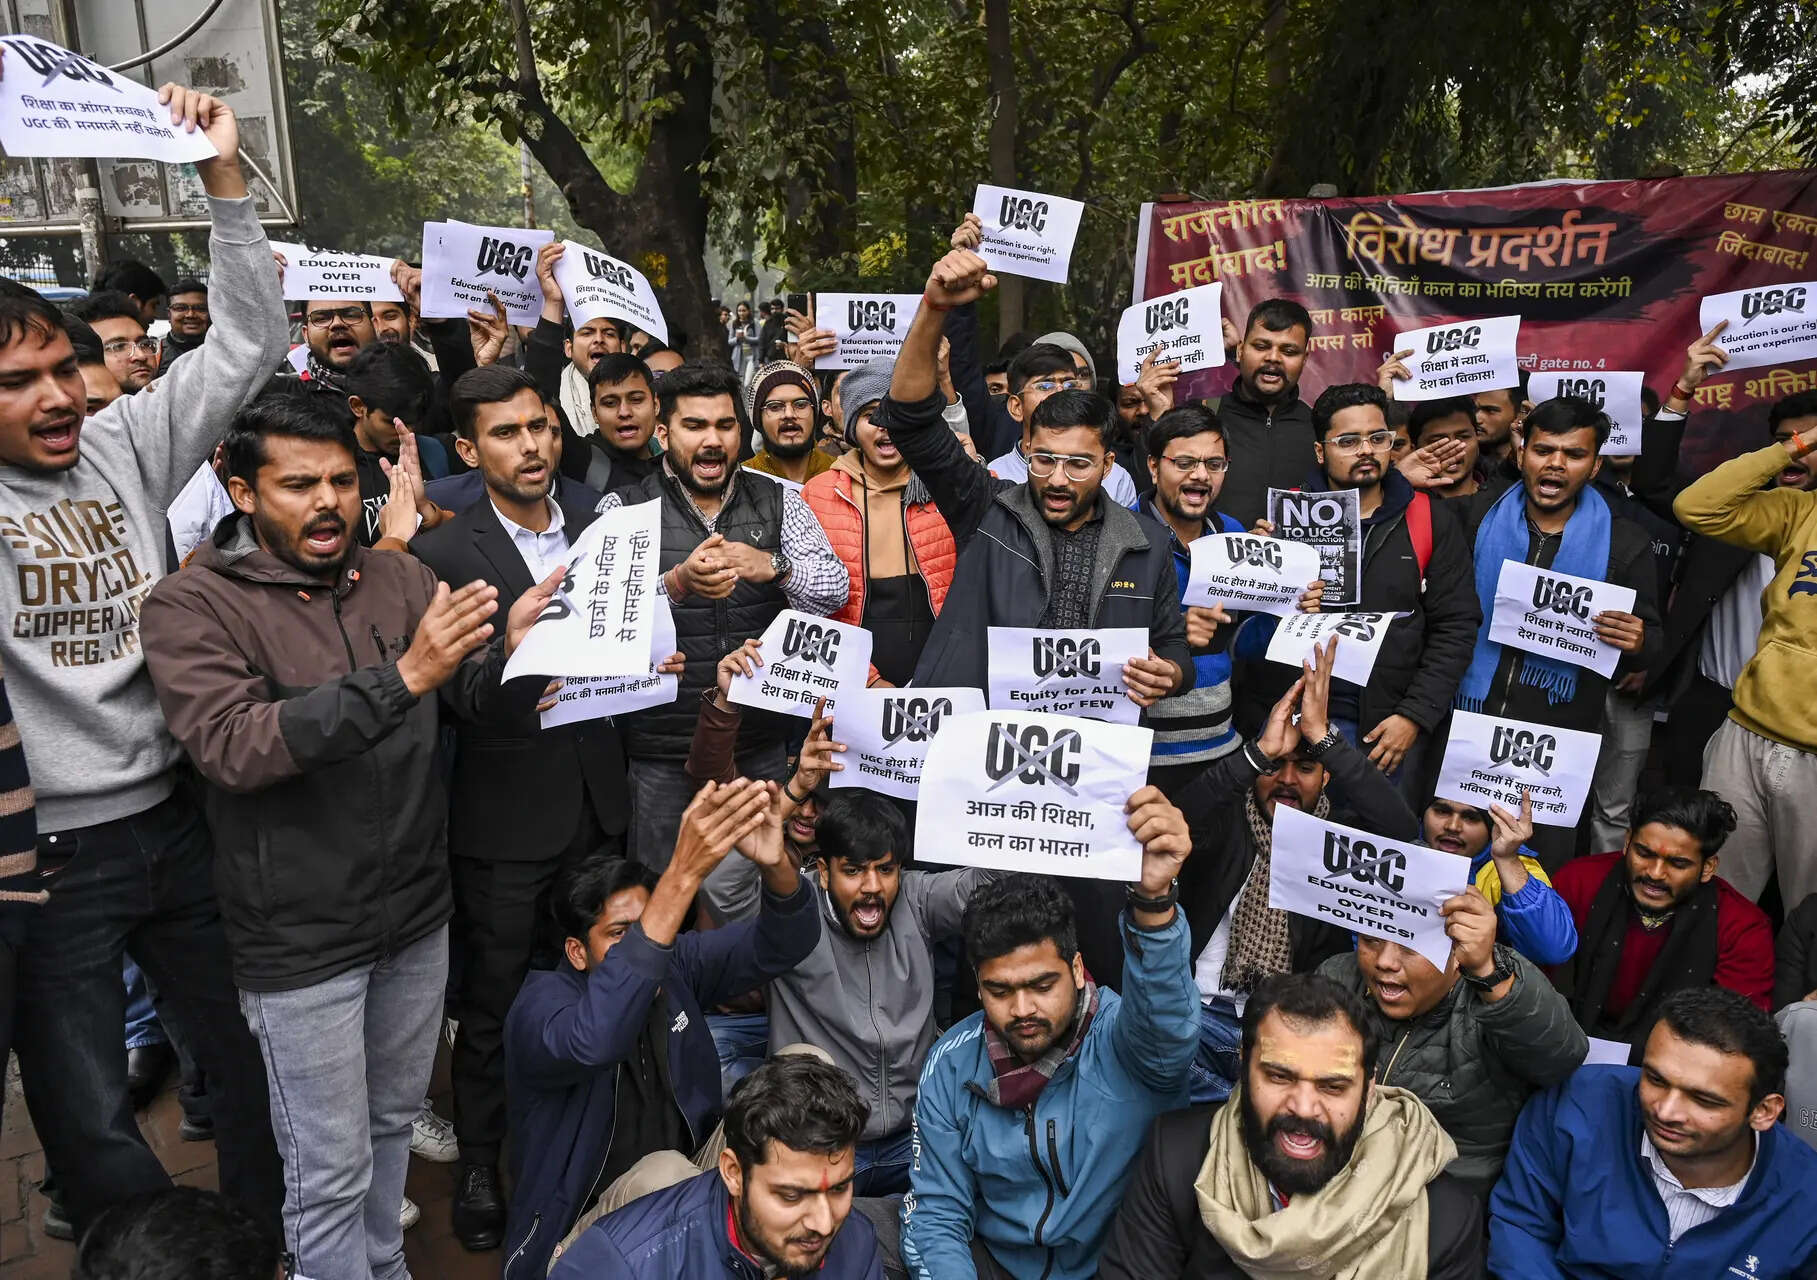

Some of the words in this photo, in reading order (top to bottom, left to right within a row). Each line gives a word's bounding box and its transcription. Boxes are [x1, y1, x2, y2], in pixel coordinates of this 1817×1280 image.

[21, 94, 56, 110] शिक्षा
[60, 101, 75, 113] का
[80, 100, 112, 114] आंगन
[148, 107, 157, 122] है
[22, 117, 52, 129] UGC
[52, 117, 72, 130] की
[76, 120, 122, 132] मनमानी
[124, 122, 144, 134] नहीं
[1000, 196, 1048, 232] UGC
[1724, 202, 1767, 224] छात्र
[981, 234, 1014, 248] Education
[1022, 243, 1035, 251] our
[1346, 211, 1462, 265] विरोध
[1464, 209, 1617, 272] प्रदर्शन
[1716, 231, 1808, 270] जिंदाबाद!
[299, 260, 381, 269] EDUCATION
[477, 236, 533, 279] UGC
[984, 247, 996, 255] not
[1008, 252, 1050, 264] experiment!
[322, 273, 361, 281] OVER
[583, 252, 635, 292] UGC
[1304, 273, 1341, 289] आज
[1344, 273, 1363, 290] की
[1364, 275, 1420, 297] नीतियाँ
[1423, 284, 1453, 297] कल
[1458, 282, 1481, 297] का
[1485, 278, 1541, 298] भविष्य
[1546, 282, 1573, 298] तय
[1579, 275, 1632, 298] करेंगी
[309, 285, 376, 294] POLITICS!
[451, 277, 492, 293] Education
[493, 286, 500, 295] is
[501, 290, 516, 298] our
[516, 291, 537, 302] right,
[454, 291, 469, 300] not
[470, 295, 481, 303] an
[1741, 287, 1807, 319] UGC
[848, 300, 896, 331] UGC
[1145, 297, 1189, 334] UGC
[1340, 305, 1385, 326] कानून
[1160, 340, 1170, 351] के
[1172, 335, 1201, 348] भविष्य
[1351, 328, 1373, 348] लो
[1427, 326, 1481, 354] UGC
[1721, 331, 1769, 344] Education
[1771, 327, 1779, 335] is
[1782, 325, 1799, 333] our
[1729, 345, 1745, 354] not
[1747, 342, 1760, 351] an
[1762, 333, 1817, 348] experimen
[840, 348, 869, 356] justice
[1184, 349, 1205, 364] नहीं!
[1421, 359, 1449, 373] शिक्षा
[1450, 356, 1459, 367] में
[1461, 353, 1489, 365] न्याय,
[1540, 359, 1569, 370] gate
[1573, 361, 1593, 369] no.
[1596, 358, 1606, 369] 4
[1420, 379, 1437, 390] देश
[1439, 377, 1454, 386] का
[1455, 370, 1495, 384] विकास!
[1694, 383, 1734, 409] राष्ट्र
[1282, 498, 1343, 527] NO
[1283, 527, 1304, 537] TO
[1309, 526, 1343, 537] UGC
[595, 536, 619, 578] भविष्य
[1225, 536, 1283, 568] UGC
[589, 581, 610, 598] के
[620, 564, 646, 624] समझौता
[1208, 586, 1234, 598] विरोधी
[1234, 591, 1255, 601] नियम
[1212, 575, 1230, 584] UGC
[1230, 576, 1247, 587] होश
[1256, 582, 1278, 593] आओ,
[1533, 575, 1593, 619] UGC
[13, 606, 114, 638] COPPER
[1524, 612, 1553, 629] शिक्षा
[1555, 620, 1565, 632] में
[1567, 626, 1596, 642] न्याय,
[52, 640, 105, 667] REG.
[782, 618, 841, 666] UGC
[1518, 626, 1536, 641] देश
[1538, 634, 1554, 646] का
[1555, 636, 1597, 659] विकास!
[1032, 637, 1100, 678] UGC
[560, 692, 577, 702] UGC
[580, 688, 591, 699] की
[595, 683, 625, 697] मनमानी
[627, 680, 640, 691] नहीं
[641, 675, 661, 689] चलेगी
[770, 662, 800, 681] शिक्षा
[802, 670, 813, 684] में
[812, 674, 839, 690] न्याय
[761, 681, 781, 697] देश
[782, 688, 799, 701] का
[1010, 689, 1059, 703] Equity
[1065, 688, 1086, 696] for
[1092, 686, 1127, 698] ALL,
[882, 697, 953, 742] UGC
[1053, 702, 1074, 712] for
[1080, 700, 1114, 709] FEW
[860, 753, 883, 765] UGC
[885, 756, 907, 768] होश
[909, 757, 918, 769] में
[985, 722, 1081, 787] UGC
[1490, 726, 1556, 771] UGC
[859, 763, 893, 779] विरोधी
[894, 771, 921, 785] नियम
[1472, 769, 1503, 785] नियमों
[1504, 777, 1514, 788] में
[1515, 781, 1541, 794] सुधार
[1542, 786, 1563, 798] करो,
[1460, 782, 1491, 796] भविष्य
[1493, 788, 1503, 800] से
[1545, 801, 1567, 814] नहीं!
[966, 800, 1006, 819] आज
[1010, 801, 1036, 822] की
[1041, 803, 1095, 830] शिक्षा,
[967, 831, 1003, 849] कल
[1008, 834, 1034, 852] का
[1038, 838, 1090, 859] भारत!
[1323, 830, 1406, 892] UGC
[1307, 875, 1427, 917] EDUCATION
[1337, 898, 1394, 920] OVER
[1318, 903, 1415, 940] POLITICS!
